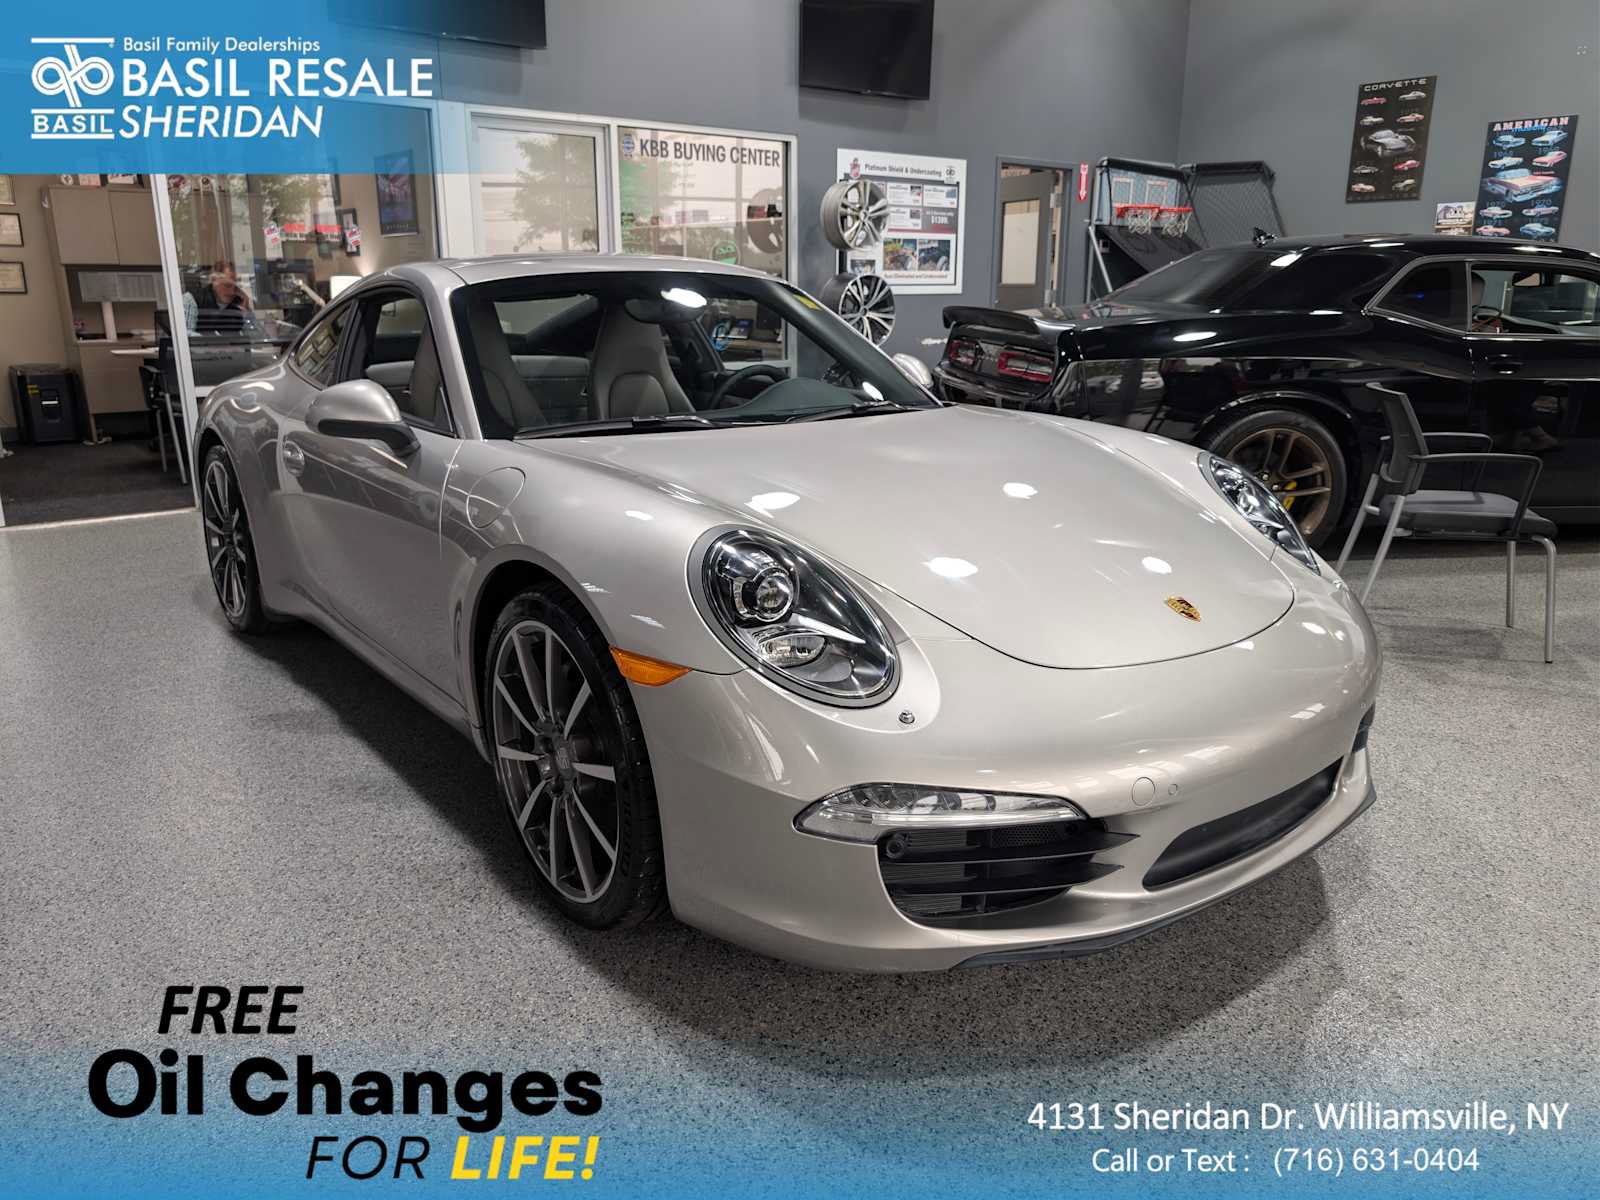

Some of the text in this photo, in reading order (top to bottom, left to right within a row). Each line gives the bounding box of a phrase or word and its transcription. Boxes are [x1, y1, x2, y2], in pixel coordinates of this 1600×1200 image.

[1364, 78, 1427, 92] CORVETTE
[1493, 116, 1569, 132] AMERICAN
[640, 138, 780, 168] KBB BUYING CENTER
